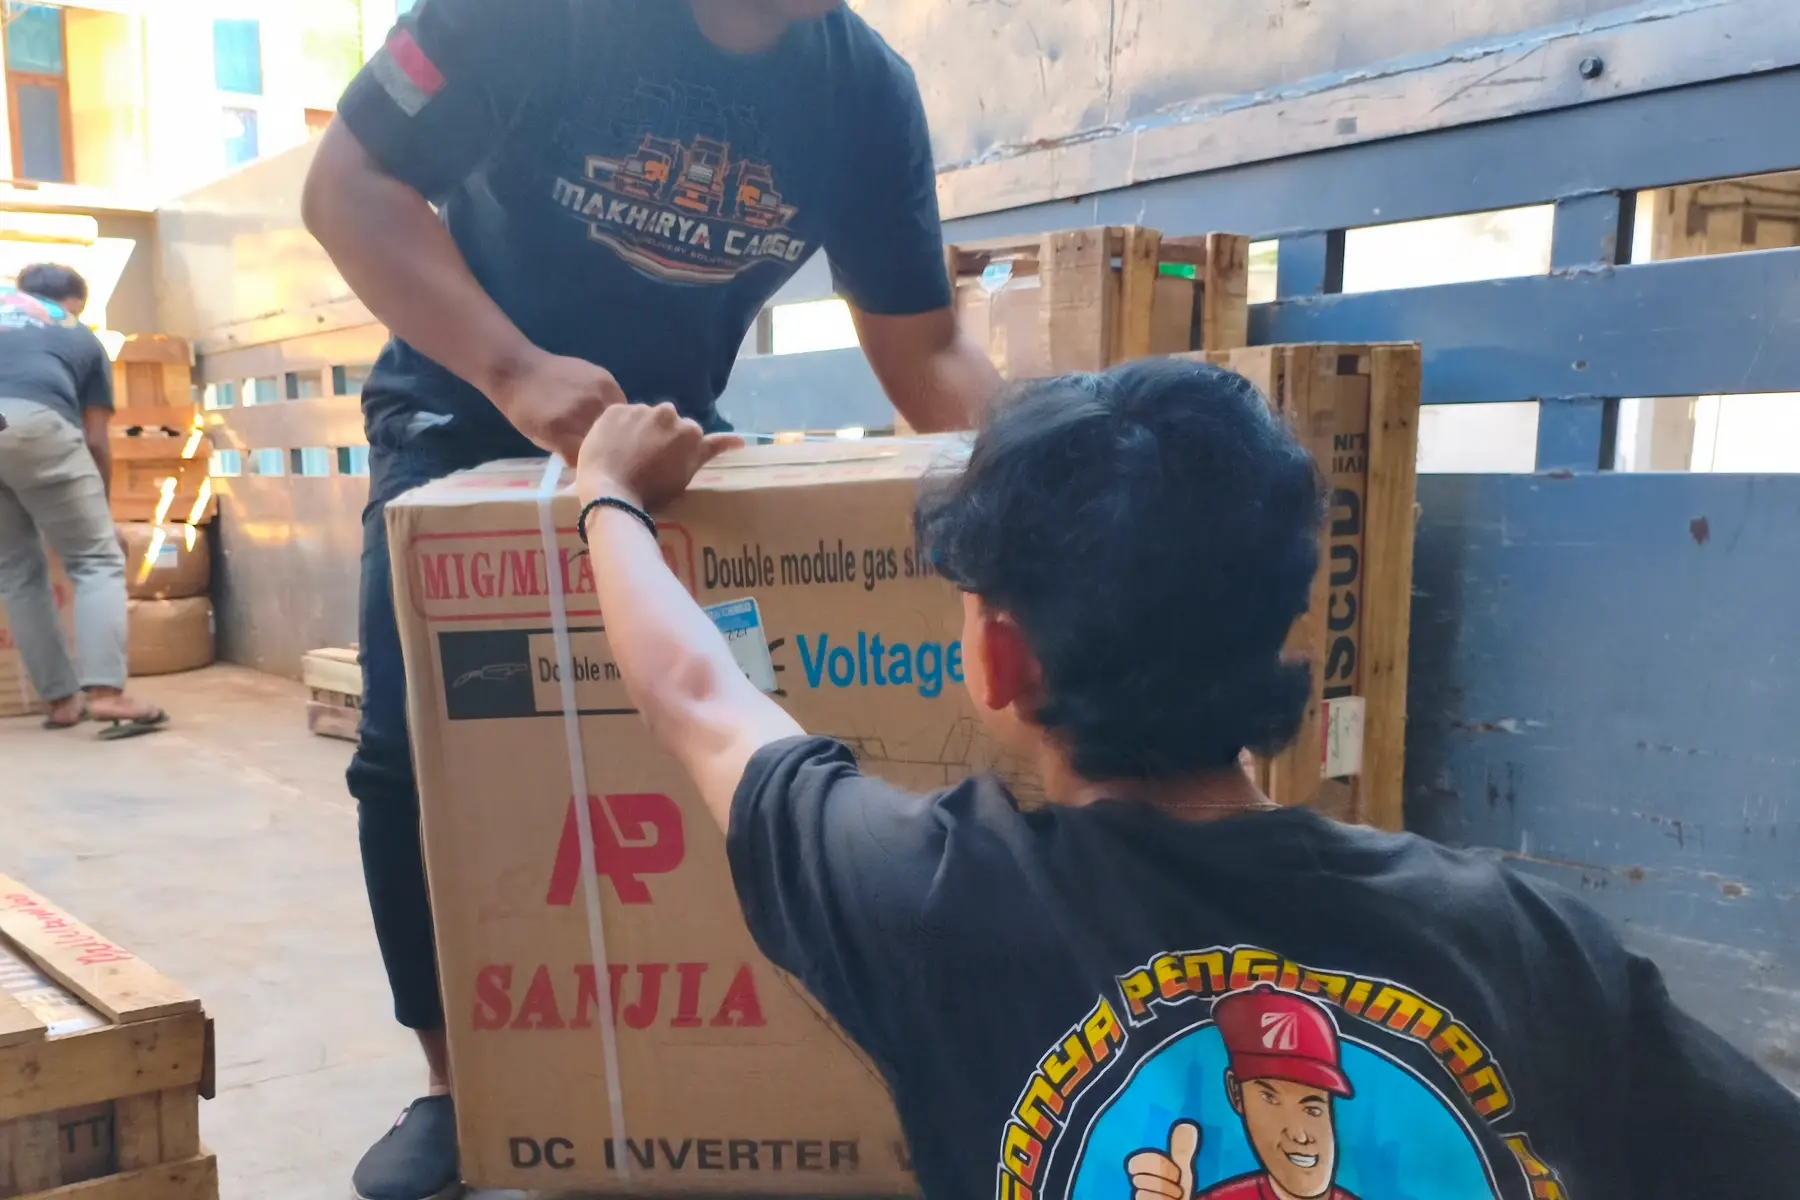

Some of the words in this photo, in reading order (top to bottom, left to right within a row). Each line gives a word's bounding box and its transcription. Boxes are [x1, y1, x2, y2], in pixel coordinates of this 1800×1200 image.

[552, 177, 711, 250] MAKHIRYA
[703, 543, 775, 590] Double
[781, 538, 856, 586] module
[863, 546, 898, 592] gas
[538, 655, 601, 683] Doble
[796, 631, 965, 699] Voltage
[473, 963, 767, 1032] SANJIA
[508, 1136, 576, 1170] DC
[603, 1137, 861, 1172] INVERTER
